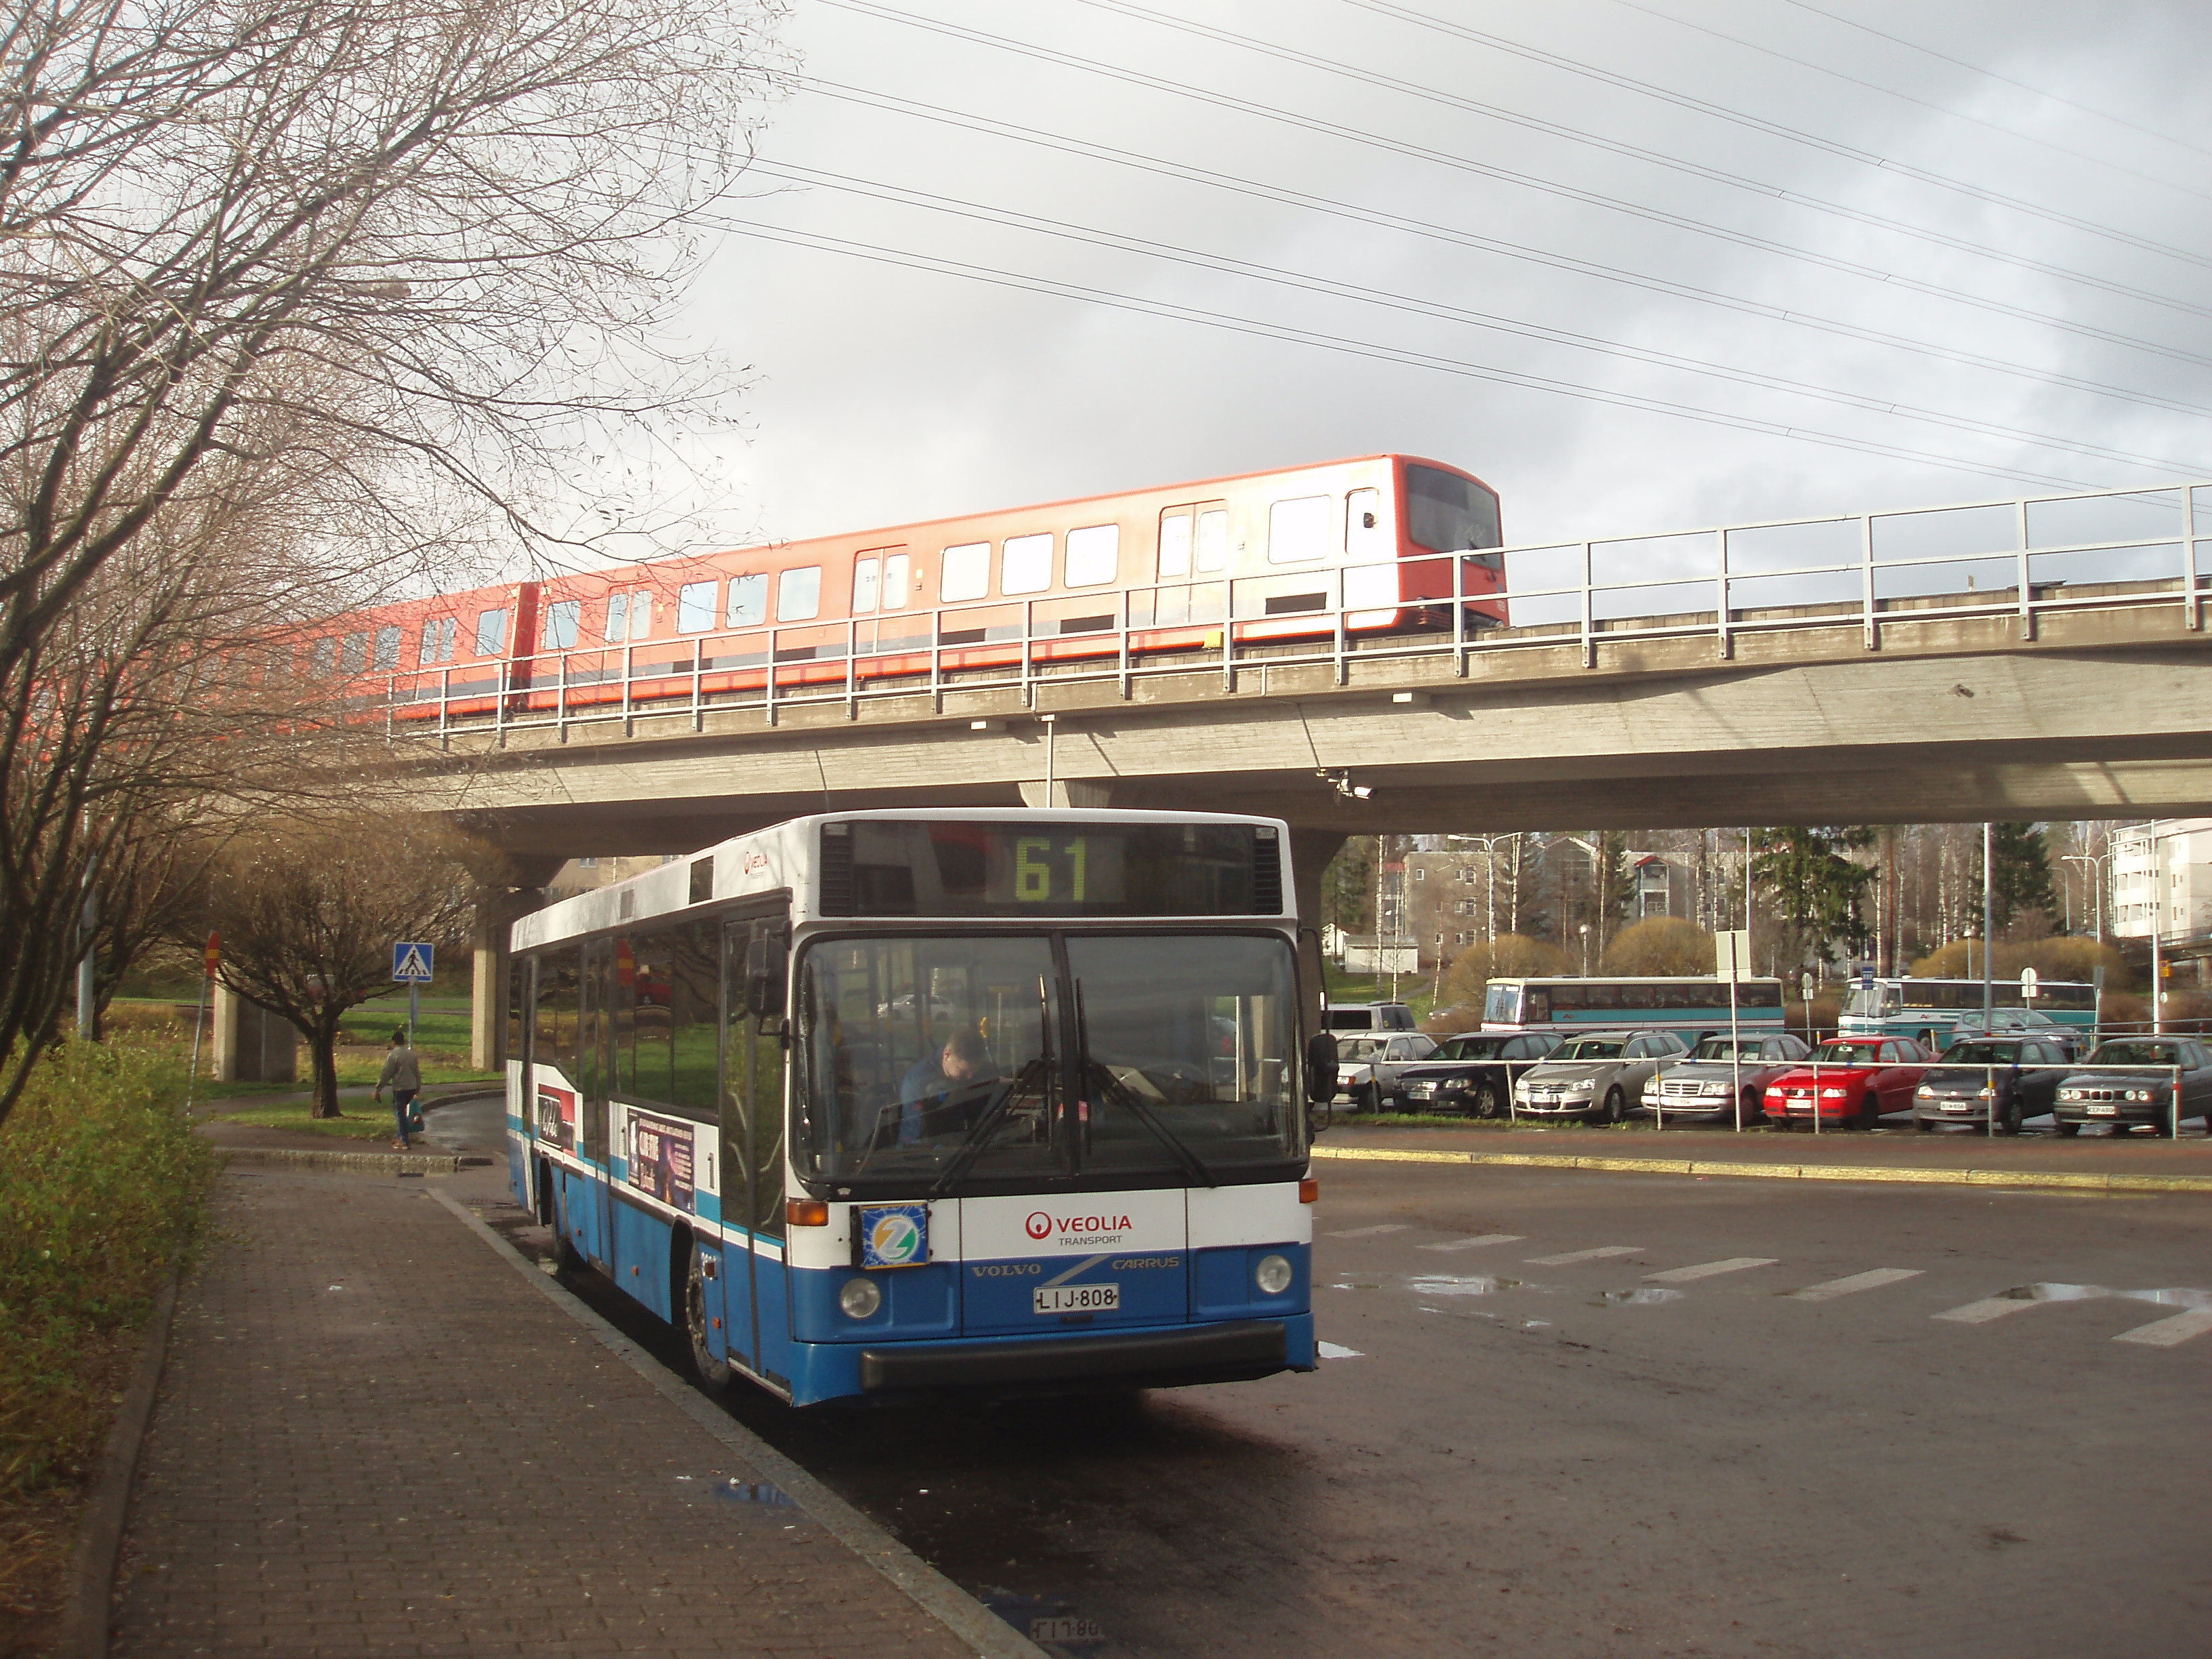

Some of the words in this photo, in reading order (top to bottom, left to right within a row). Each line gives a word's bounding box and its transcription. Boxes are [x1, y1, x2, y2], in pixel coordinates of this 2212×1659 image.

[1015, 836, 1086, 902] 61
[1056, 1215, 1132, 1233] VEOLIA
[1059, 1235, 1123, 1246] TRANSPORT
[971, 1263, 1042, 1277] VOLVO
[1111, 1256, 1180, 1270] CARRUS
